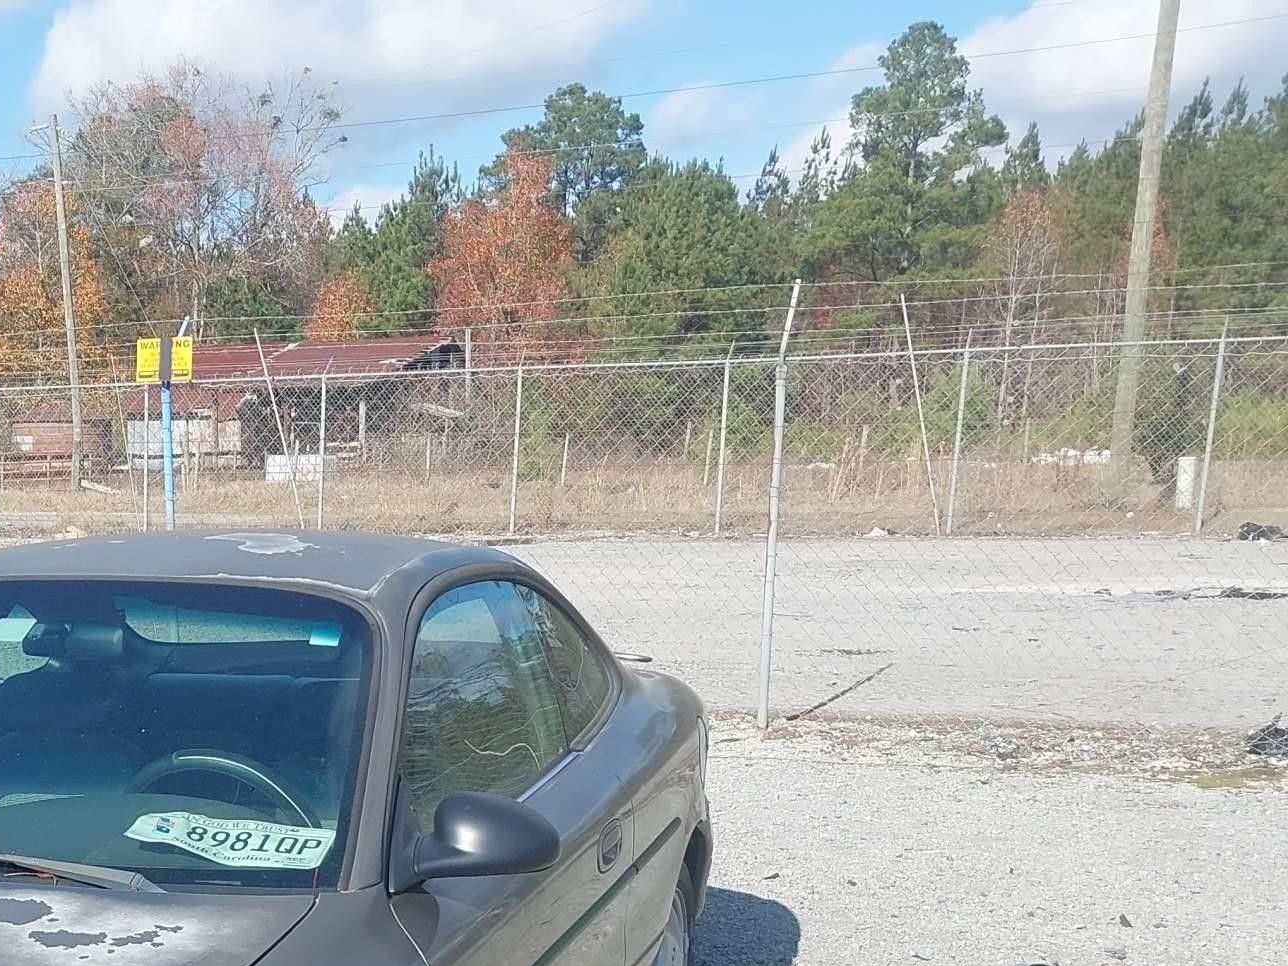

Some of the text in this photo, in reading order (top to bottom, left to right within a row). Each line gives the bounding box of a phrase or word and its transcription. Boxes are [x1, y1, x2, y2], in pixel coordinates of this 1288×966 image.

[140, 340, 190, 349] WANG
[186, 826, 322, 855] 8981QP
[212, 851, 271, 862] Carolina
